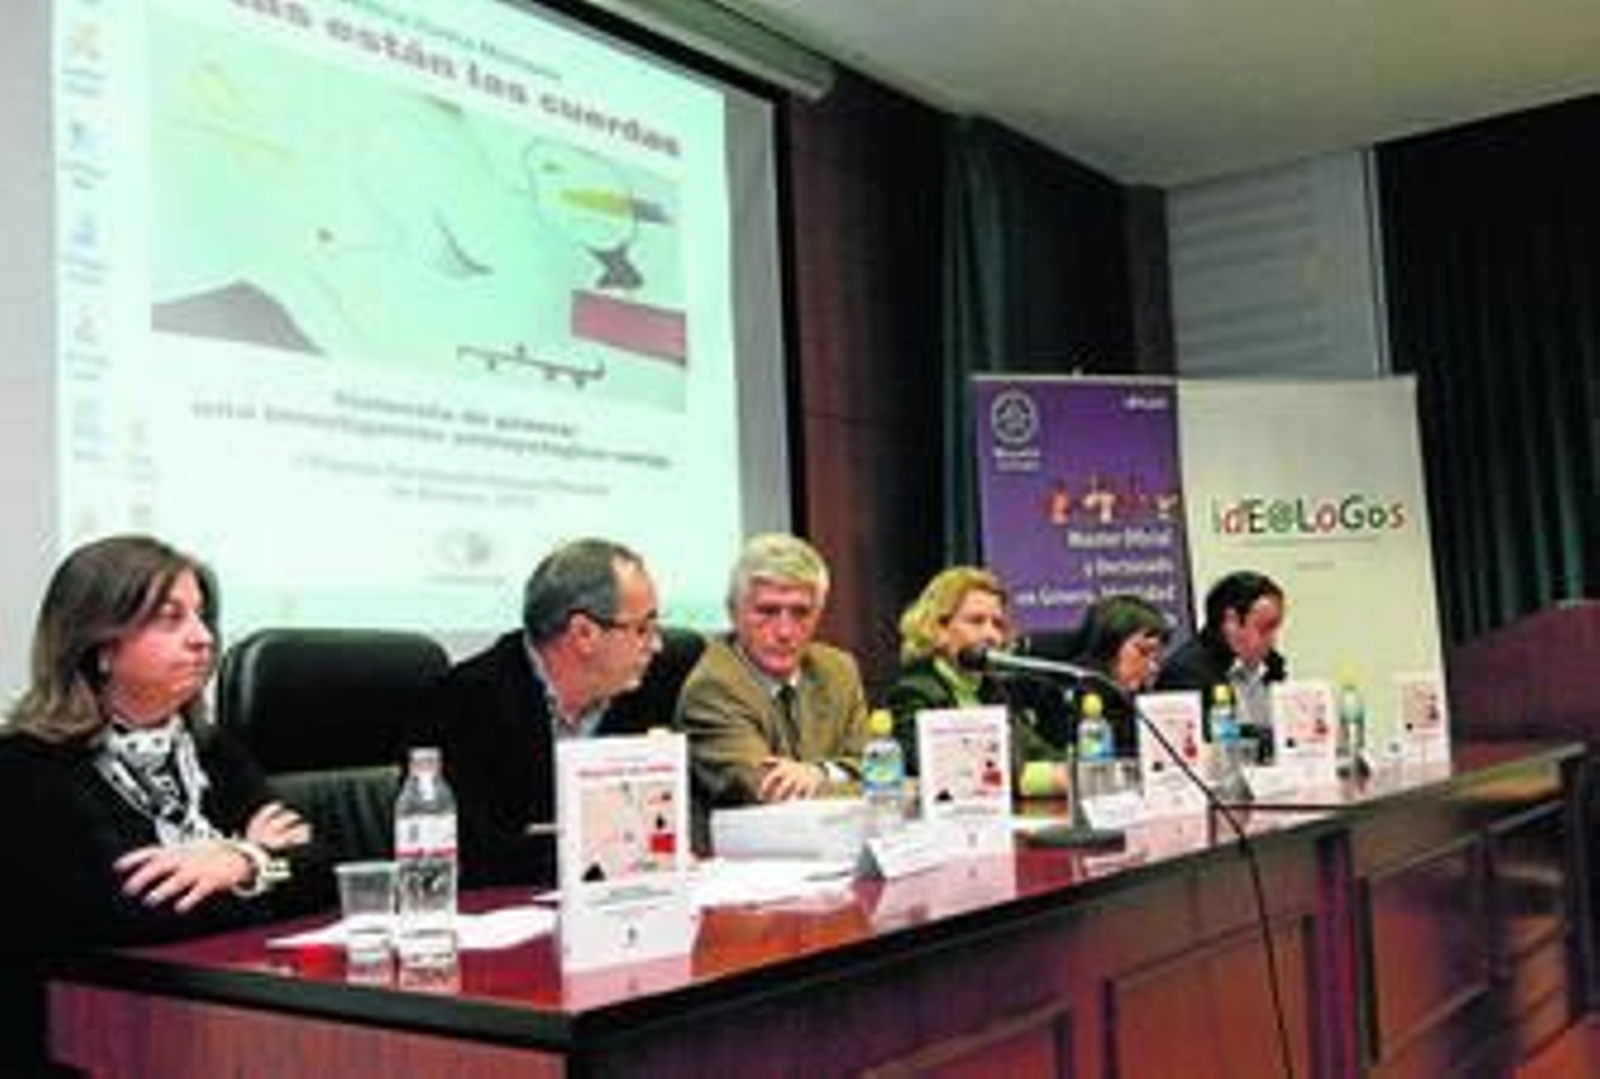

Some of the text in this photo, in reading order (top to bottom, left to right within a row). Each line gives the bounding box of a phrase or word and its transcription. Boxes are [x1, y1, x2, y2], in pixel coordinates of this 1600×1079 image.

[327, 17, 457, 79] están
[467, 61, 527, 105] las
[540, 92, 681, 157] cuerdas
